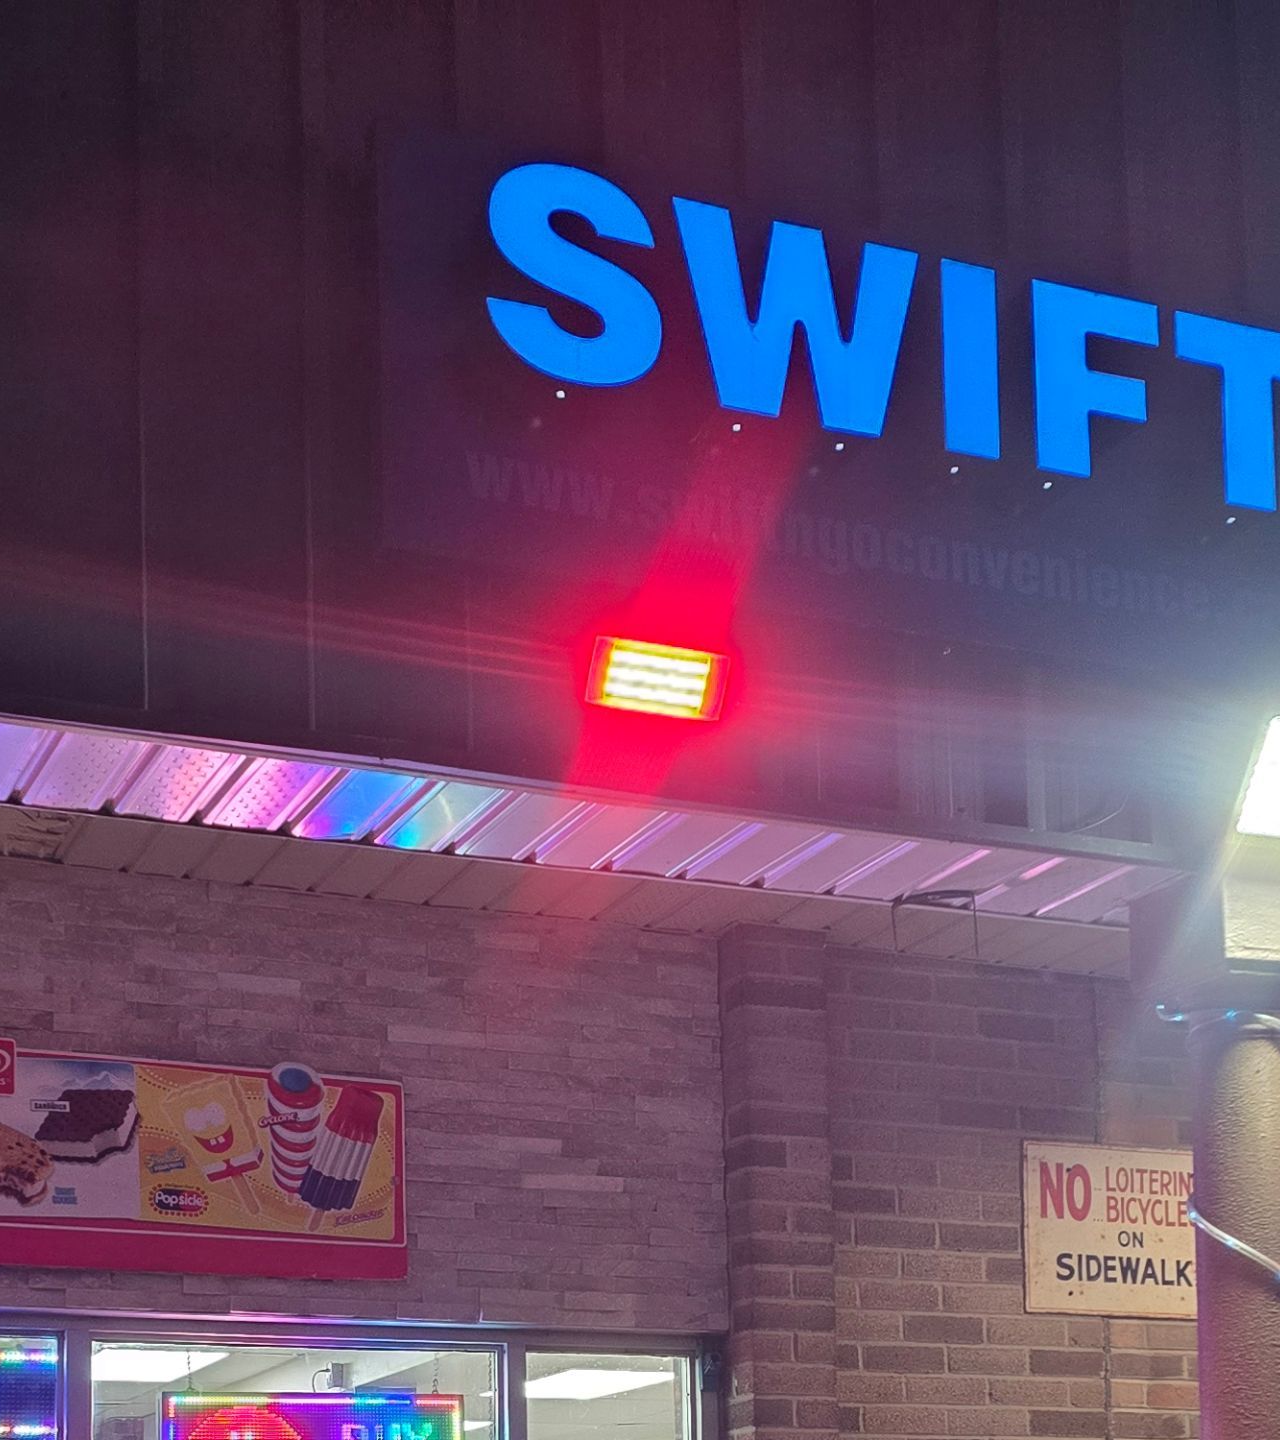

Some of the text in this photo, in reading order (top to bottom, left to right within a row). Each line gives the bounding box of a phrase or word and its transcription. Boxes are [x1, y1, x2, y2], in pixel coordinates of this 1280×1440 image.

[154, 1190, 205, 1208] Popsicle
[1039, 1161, 1194, 1222] NO LOITERIN
[1106, 1196, 1196, 1228] BICYCLE
[1118, 1231, 1144, 1249] ON
[1056, 1253, 1194, 1288] SIDEWALK
